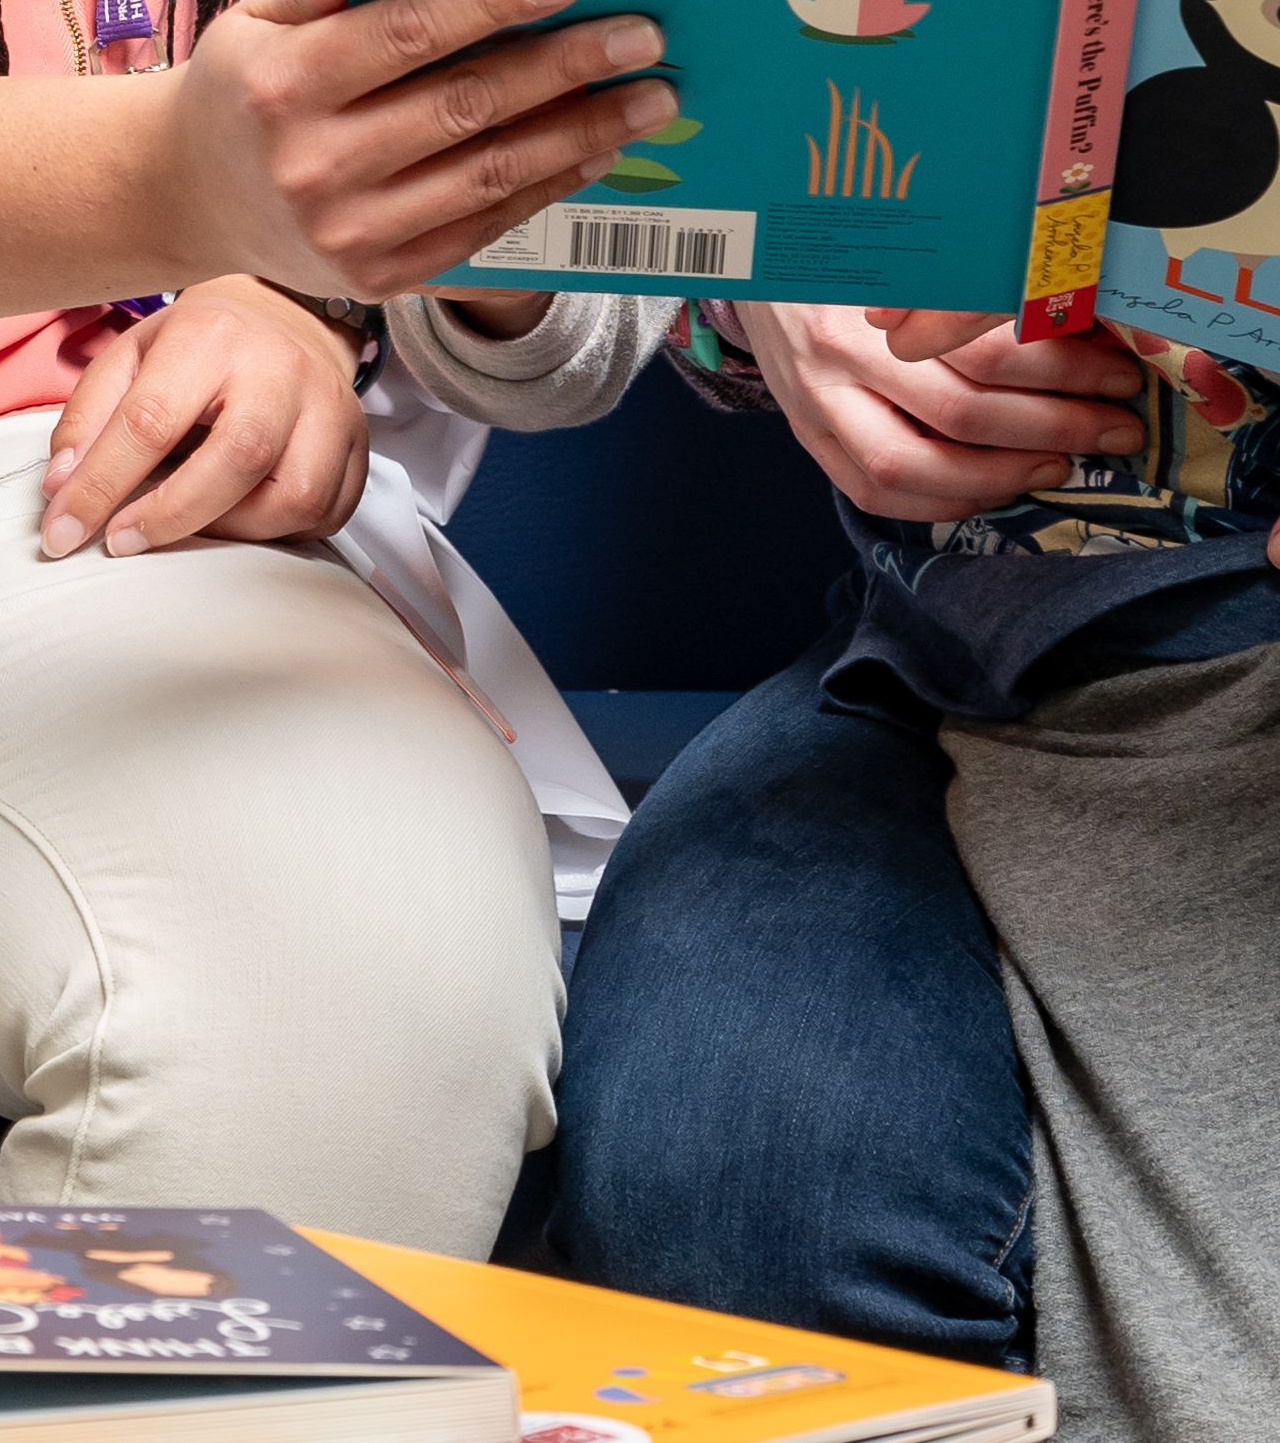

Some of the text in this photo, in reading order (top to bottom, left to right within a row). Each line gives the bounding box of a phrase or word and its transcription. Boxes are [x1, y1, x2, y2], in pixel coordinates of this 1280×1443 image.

[1080, 40, 1105, 73] the
[1070, 76, 1102, 154] Puffin?
[1207, 312, 1236, 328] P
[55, 1334, 272, 1358] THINK
